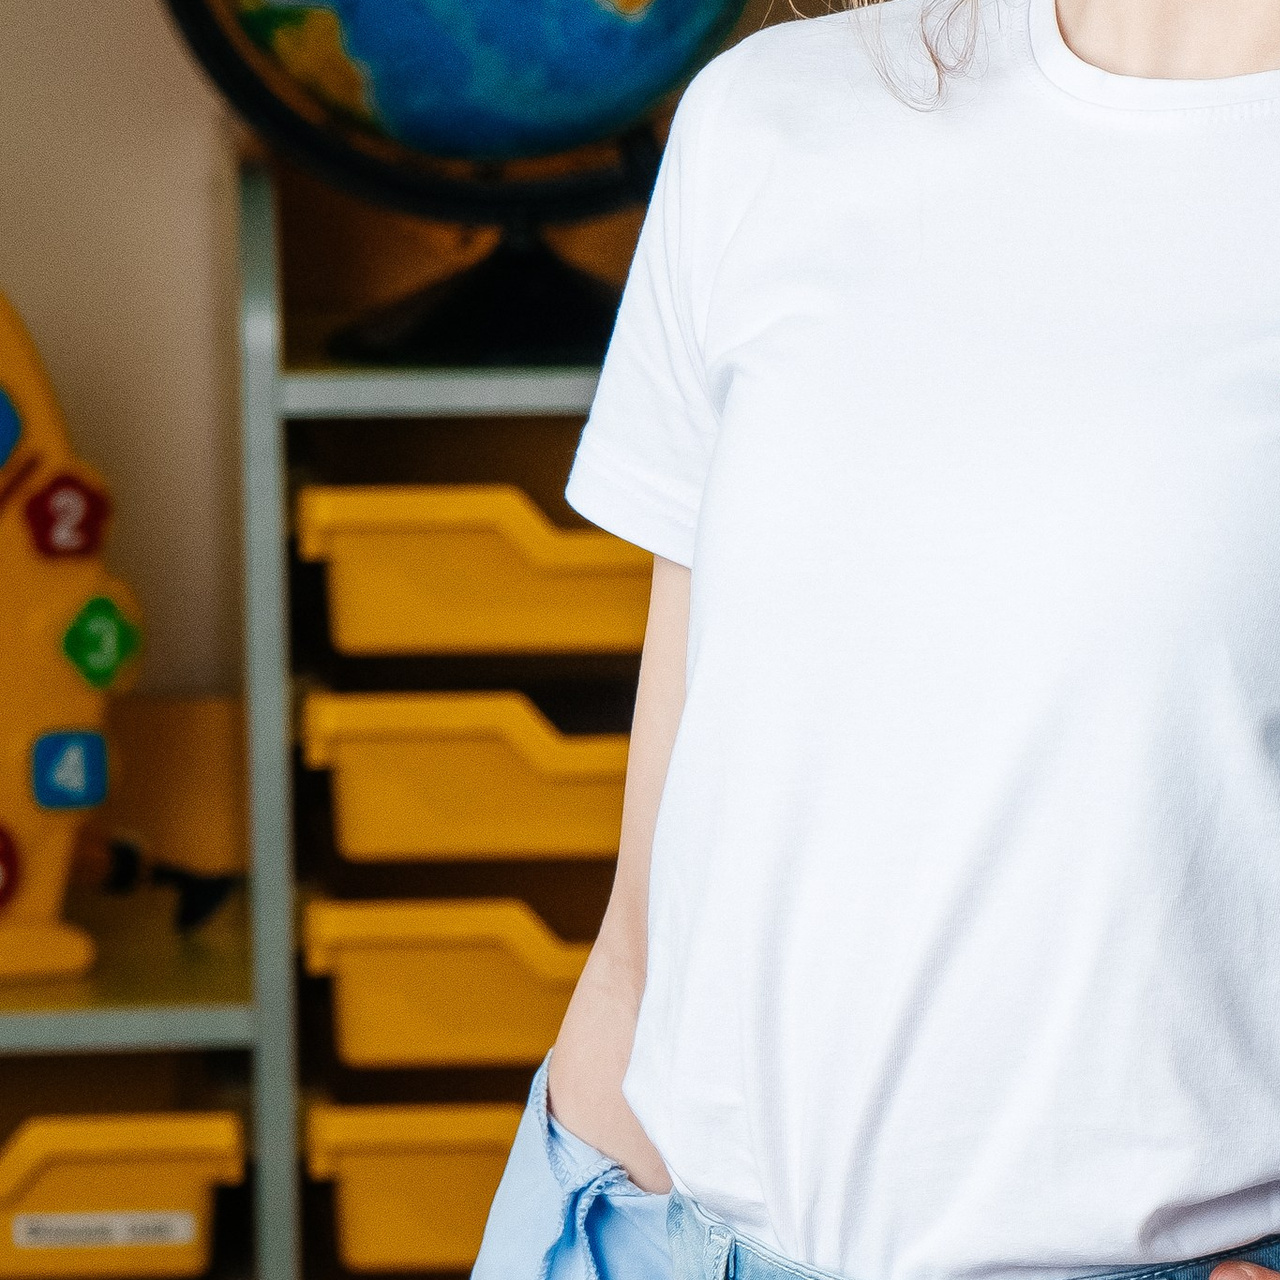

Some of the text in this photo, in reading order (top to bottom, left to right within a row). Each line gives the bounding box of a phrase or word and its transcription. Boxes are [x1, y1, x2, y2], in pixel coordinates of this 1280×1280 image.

[48, 486, 89, 551] 2
[84, 615, 118, 671] 3
[53, 742, 88, 794] 4
